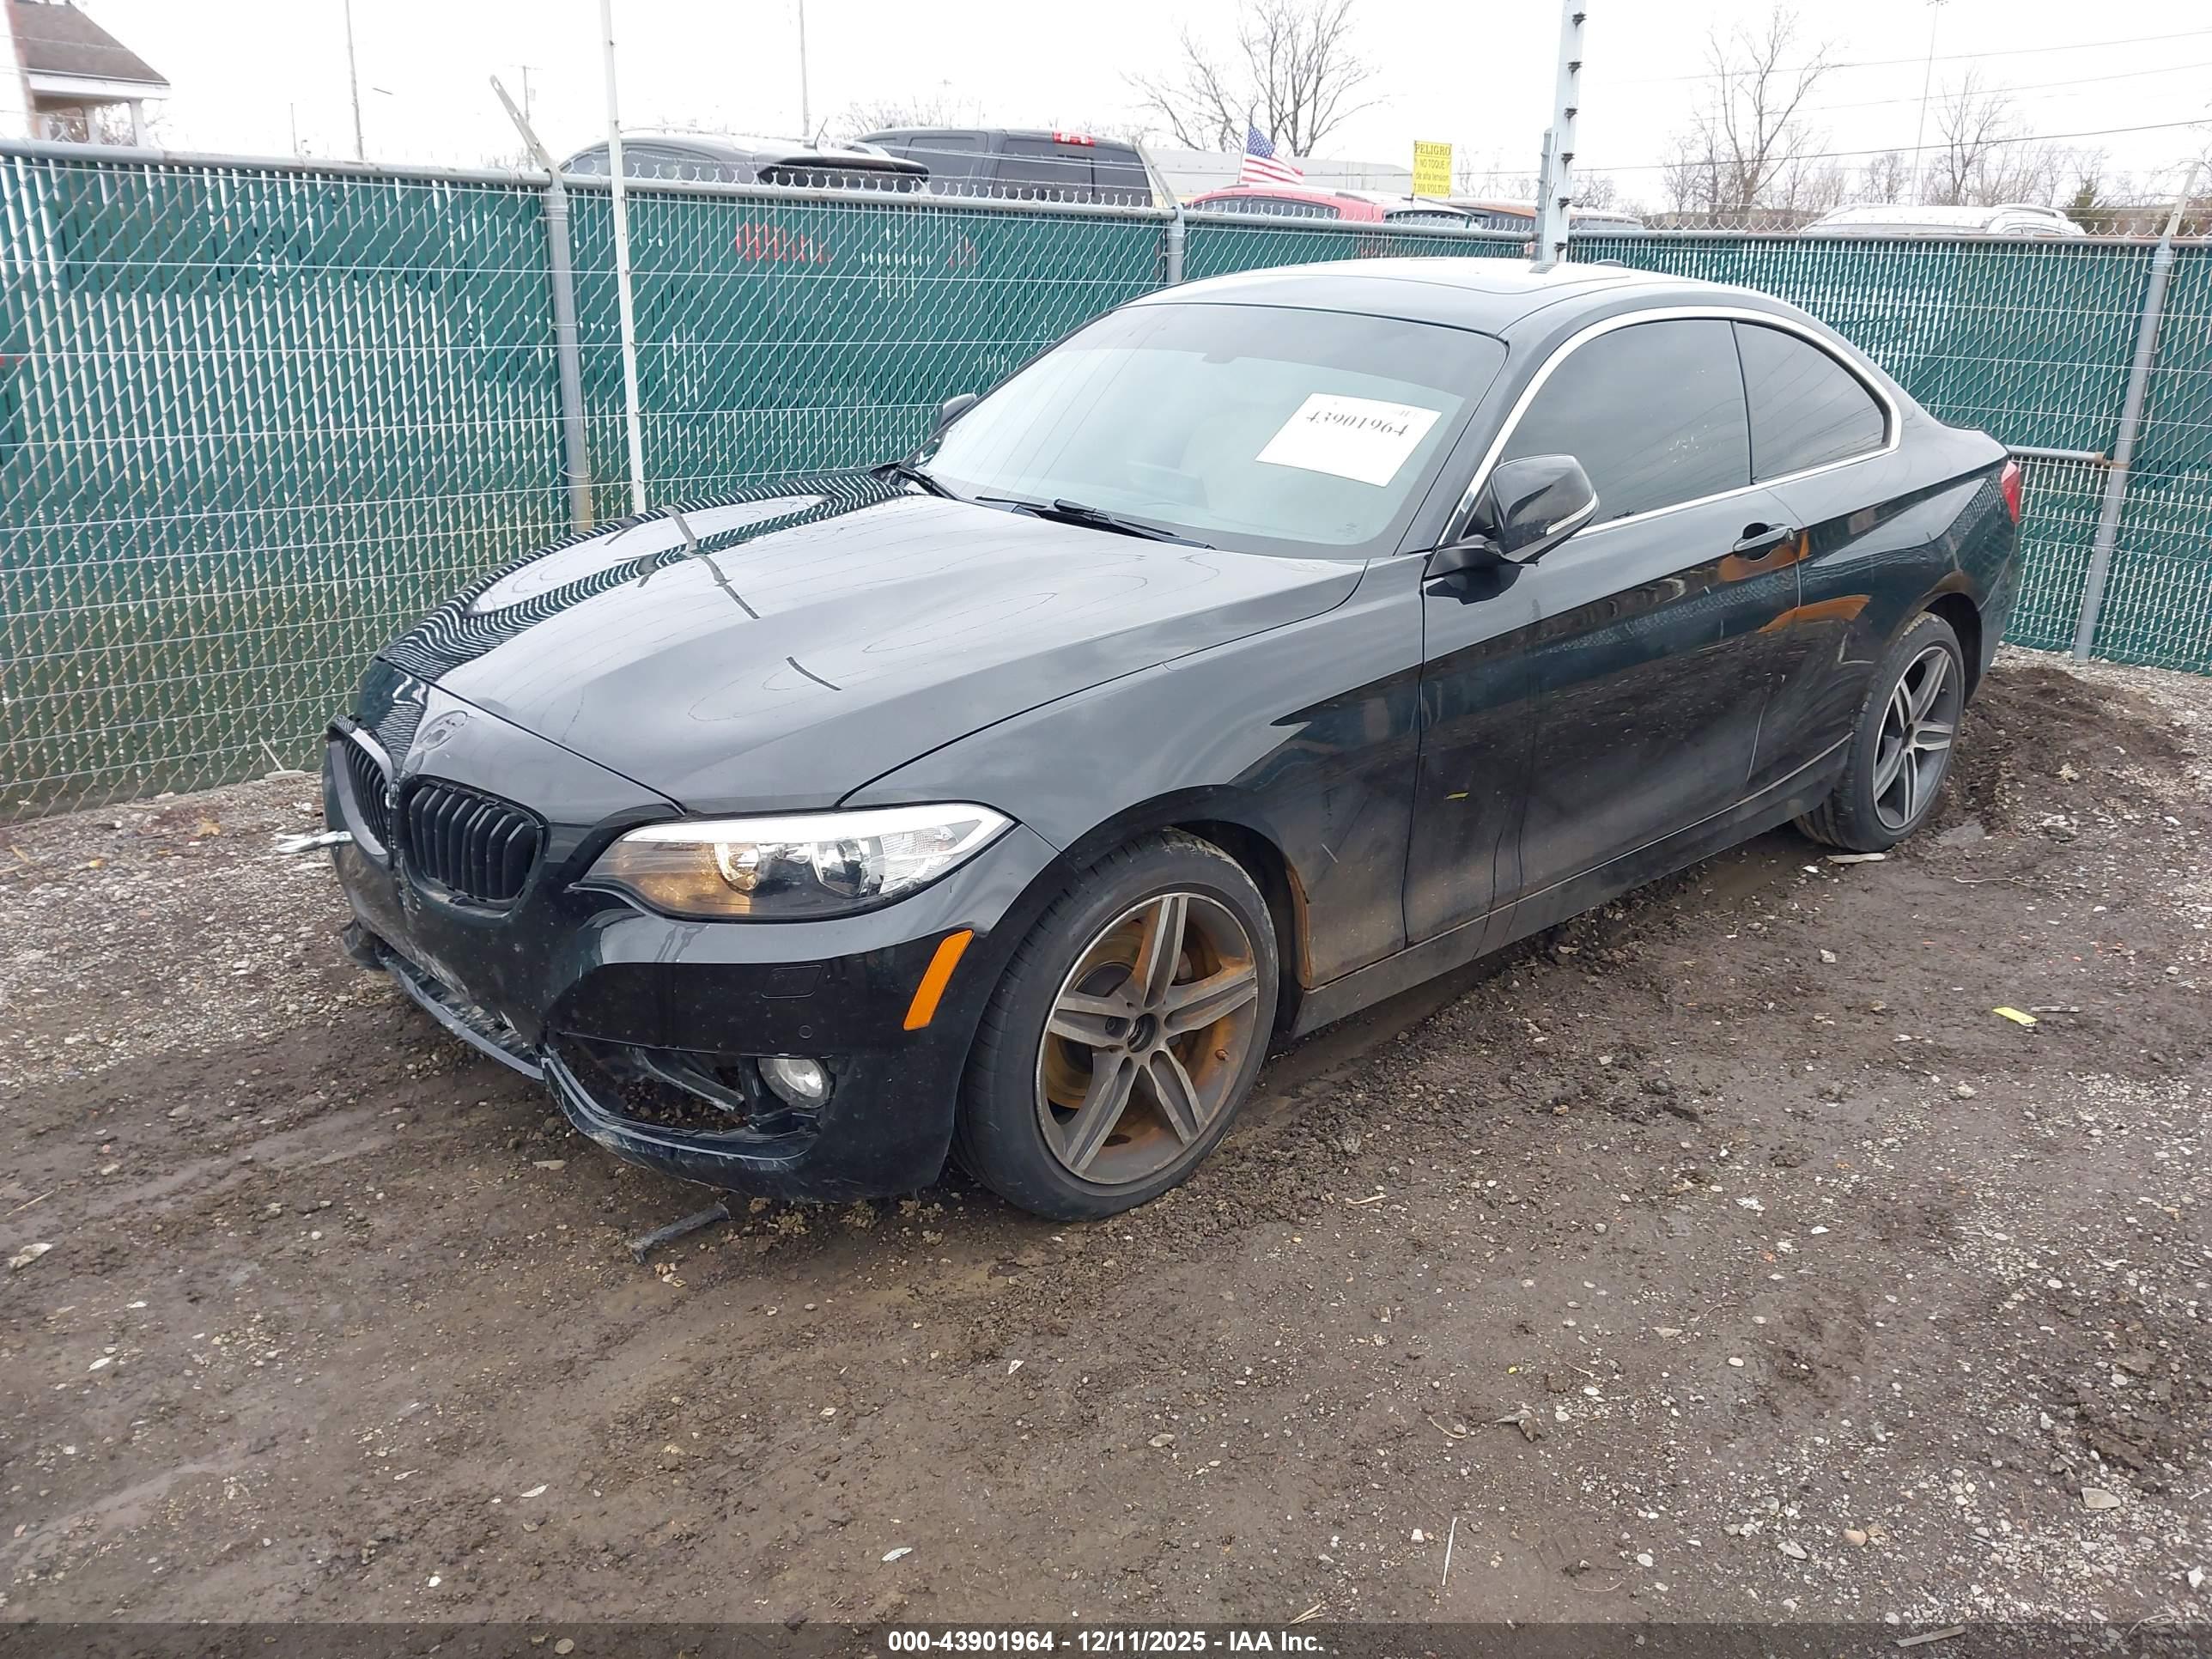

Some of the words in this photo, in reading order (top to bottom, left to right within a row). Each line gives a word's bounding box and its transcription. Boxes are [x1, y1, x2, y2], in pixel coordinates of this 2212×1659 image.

[1414, 143, 1451, 156] PELIGRO
[1419, 158, 1428, 168] NO
[1426, 183, 1450, 194] VOLTIOS
[1305, 410, 1409, 437] 43901964
